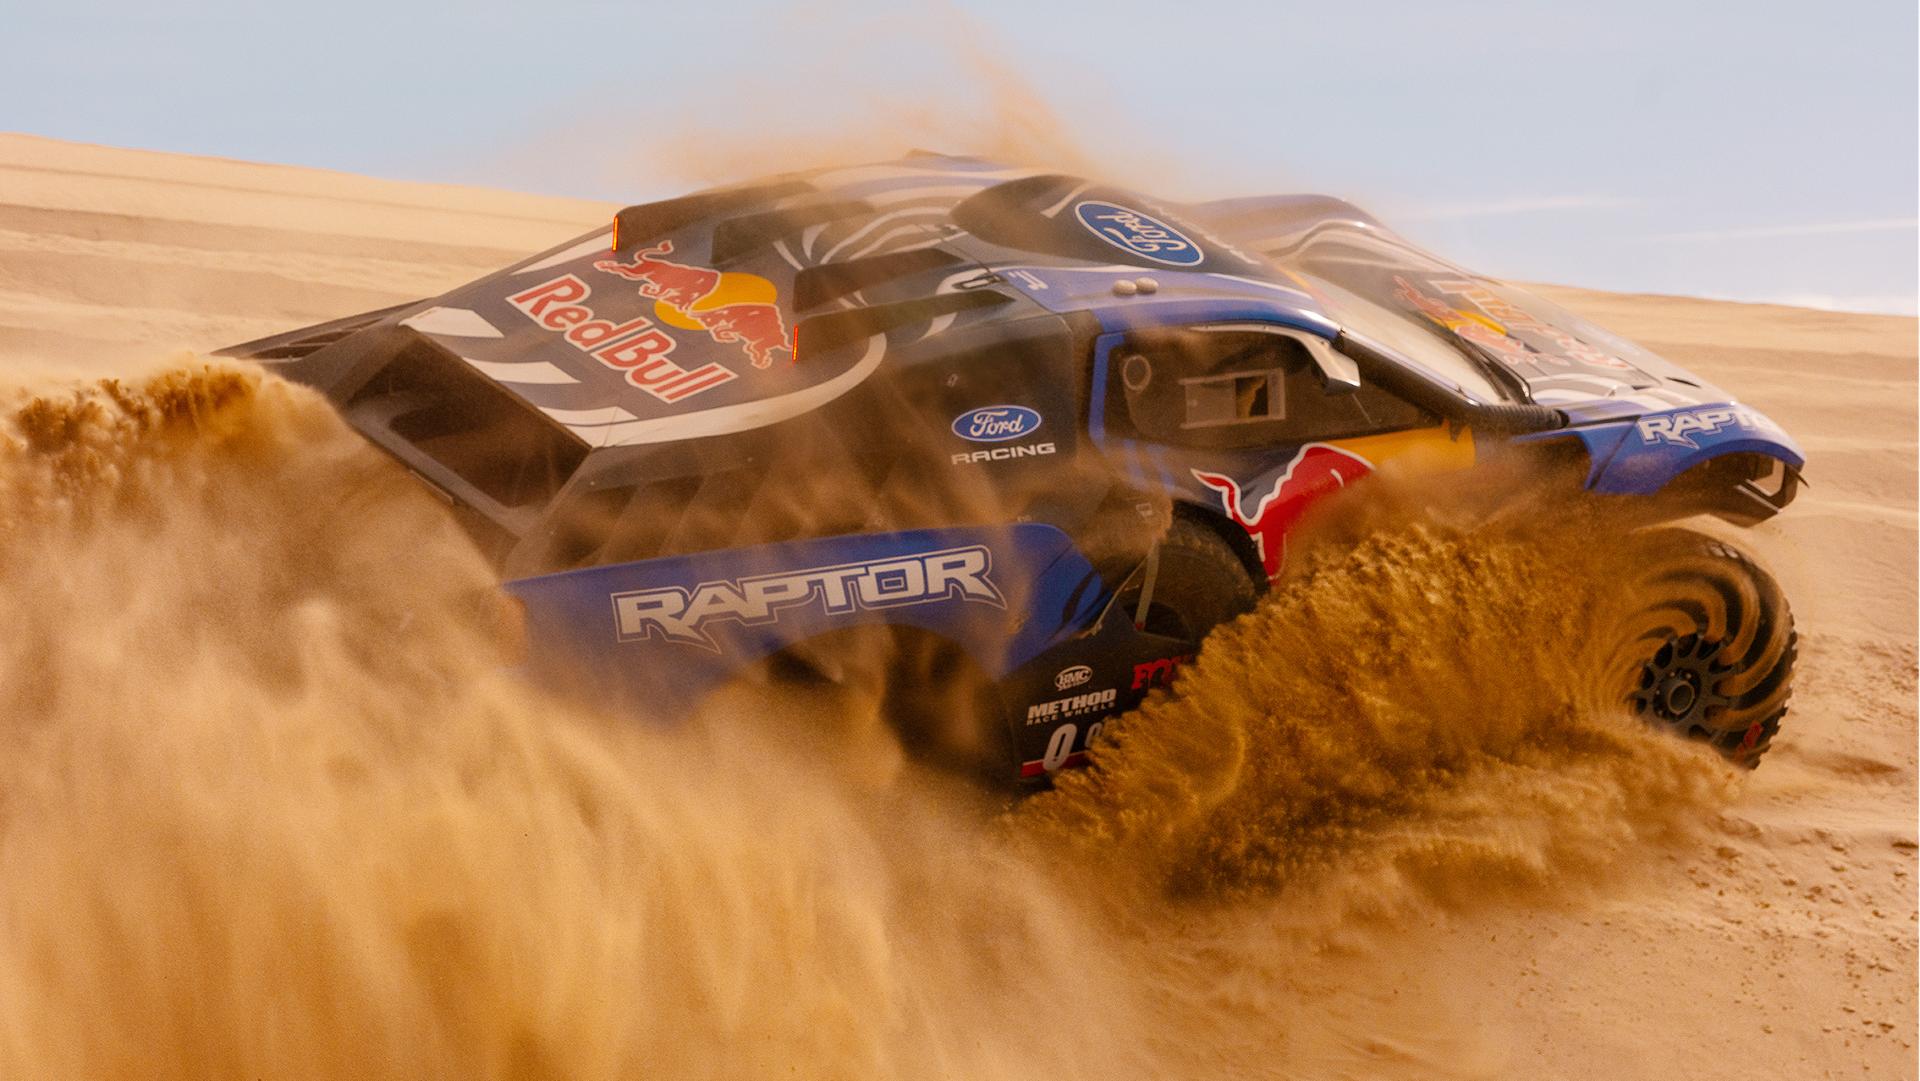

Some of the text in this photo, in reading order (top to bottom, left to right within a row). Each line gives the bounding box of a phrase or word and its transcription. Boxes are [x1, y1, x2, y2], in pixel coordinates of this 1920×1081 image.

[1096, 210, 1187, 252] Ford
[505, 274, 739, 404] Red Bull
[969, 409, 1026, 438] Ford
[951, 442, 1057, 465] RACING
[611, 544, 1008, 655] RAPTOR
[1026, 688, 1117, 721] METHOD
[1026, 702, 1116, 727] RACE WHEELS
